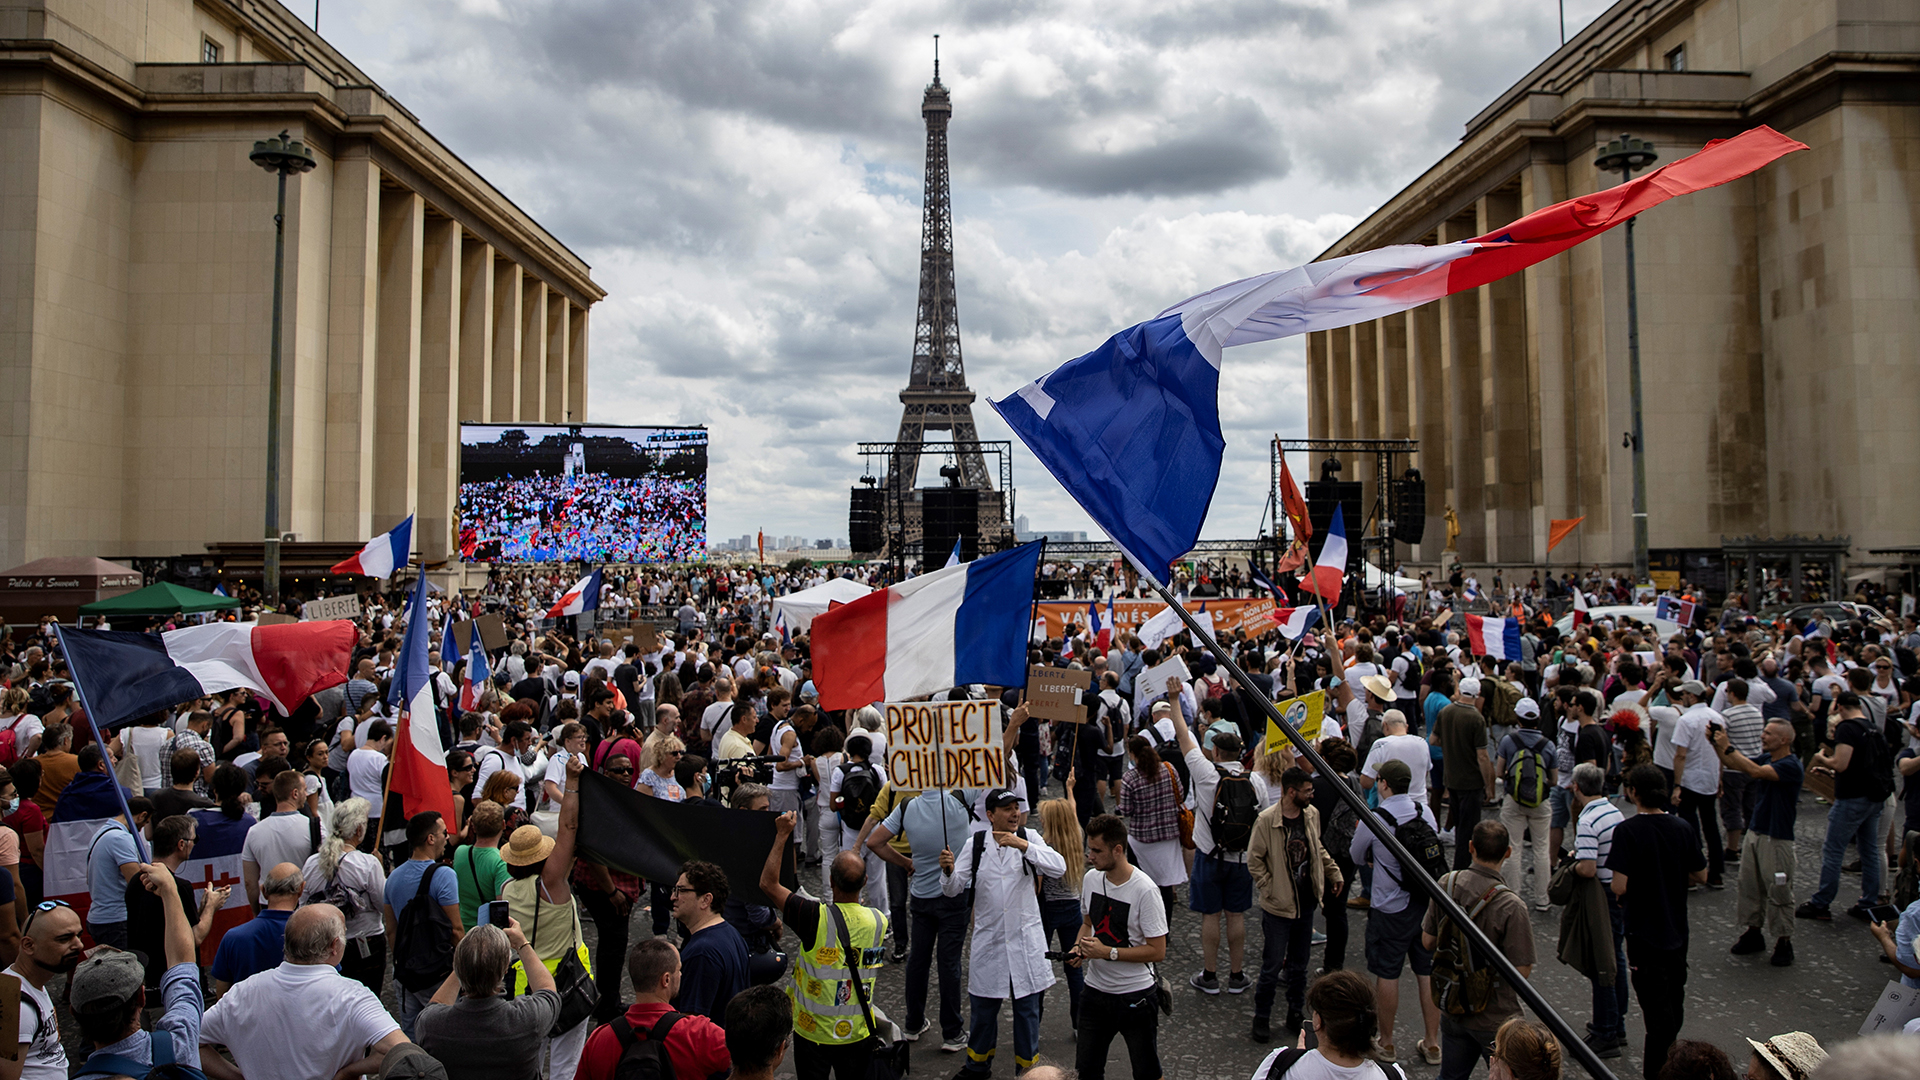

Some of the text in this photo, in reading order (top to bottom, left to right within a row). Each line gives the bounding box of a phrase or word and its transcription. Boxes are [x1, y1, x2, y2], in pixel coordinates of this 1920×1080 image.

[8, 578, 32, 588] Palais
[310, 596, 357, 620] LIBERTÉ
[1060, 608, 1150, 625] VACNÉS
[1243, 601, 1273, 619] NON AU
[1040, 683, 1078, 694] LIBERTÉ
[1030, 698, 1060, 708] IBERTÉ
[886, 701, 997, 746] PROTECT
